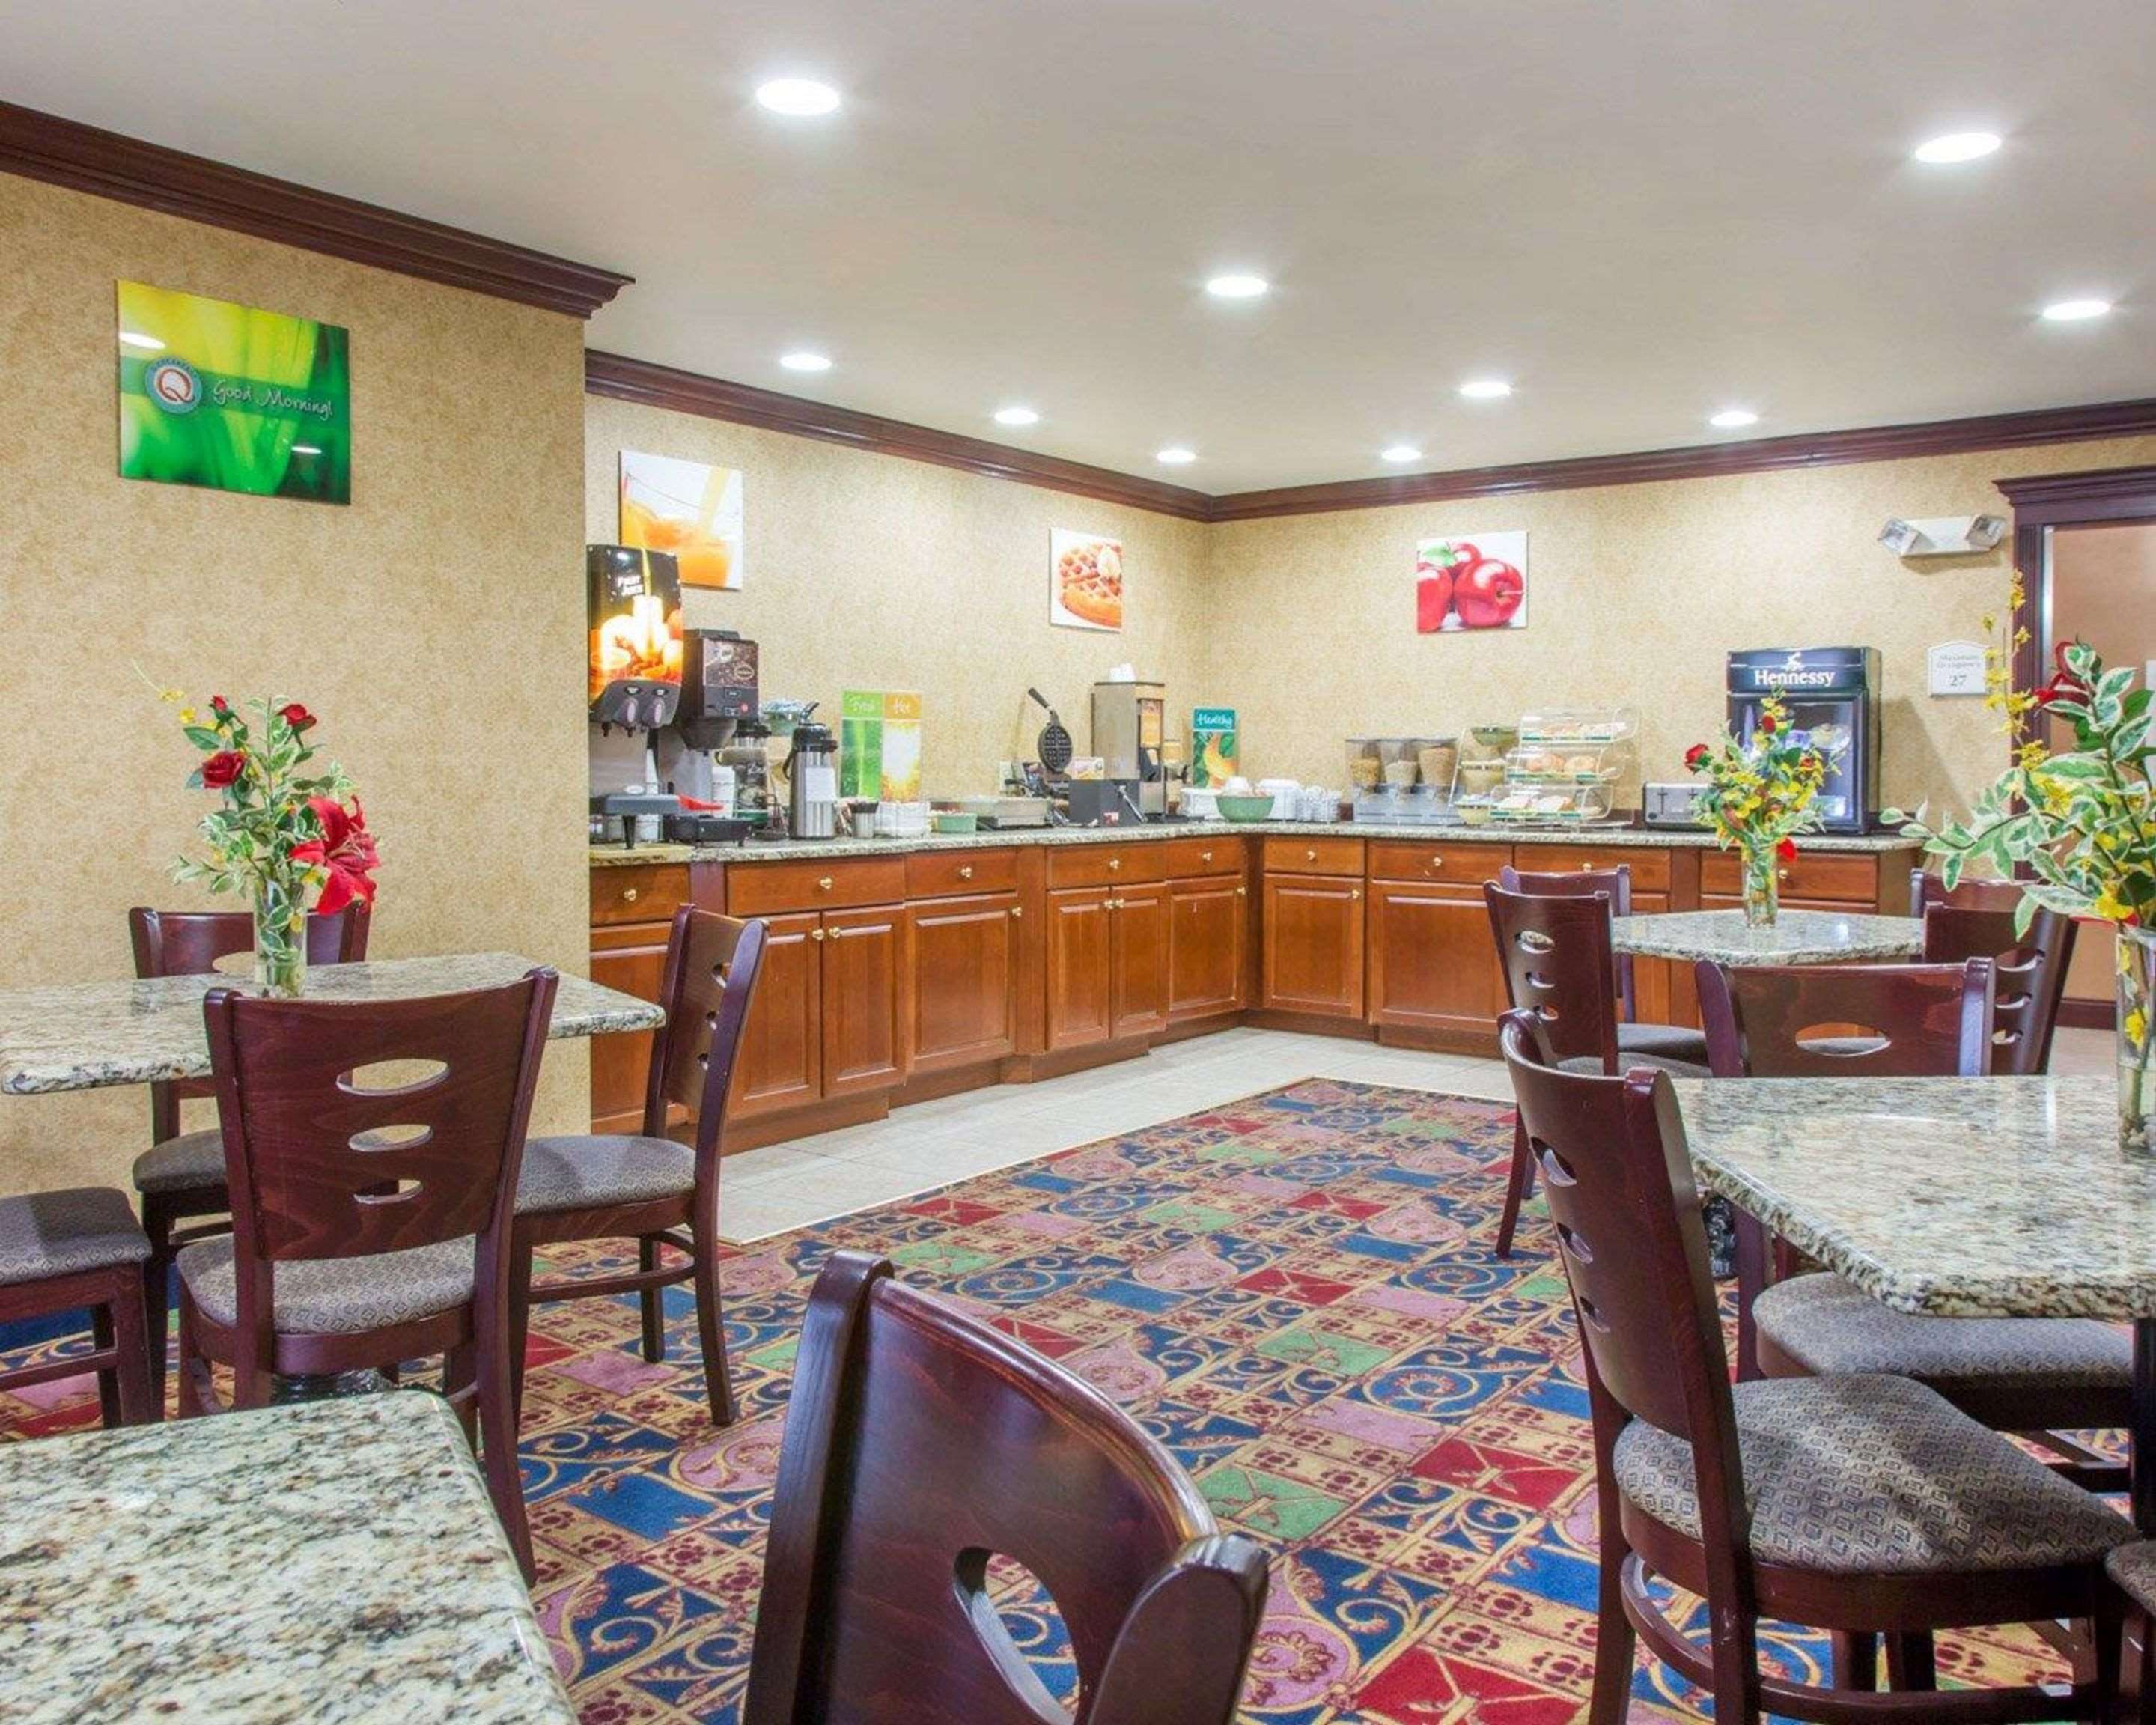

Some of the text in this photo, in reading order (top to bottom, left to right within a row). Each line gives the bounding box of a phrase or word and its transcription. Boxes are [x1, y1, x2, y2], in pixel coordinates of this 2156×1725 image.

[213, 379, 333, 421] Good Morning!
[1754, 669, 1836, 687] Hennessy
[1948, 674, 1967, 687] 27
